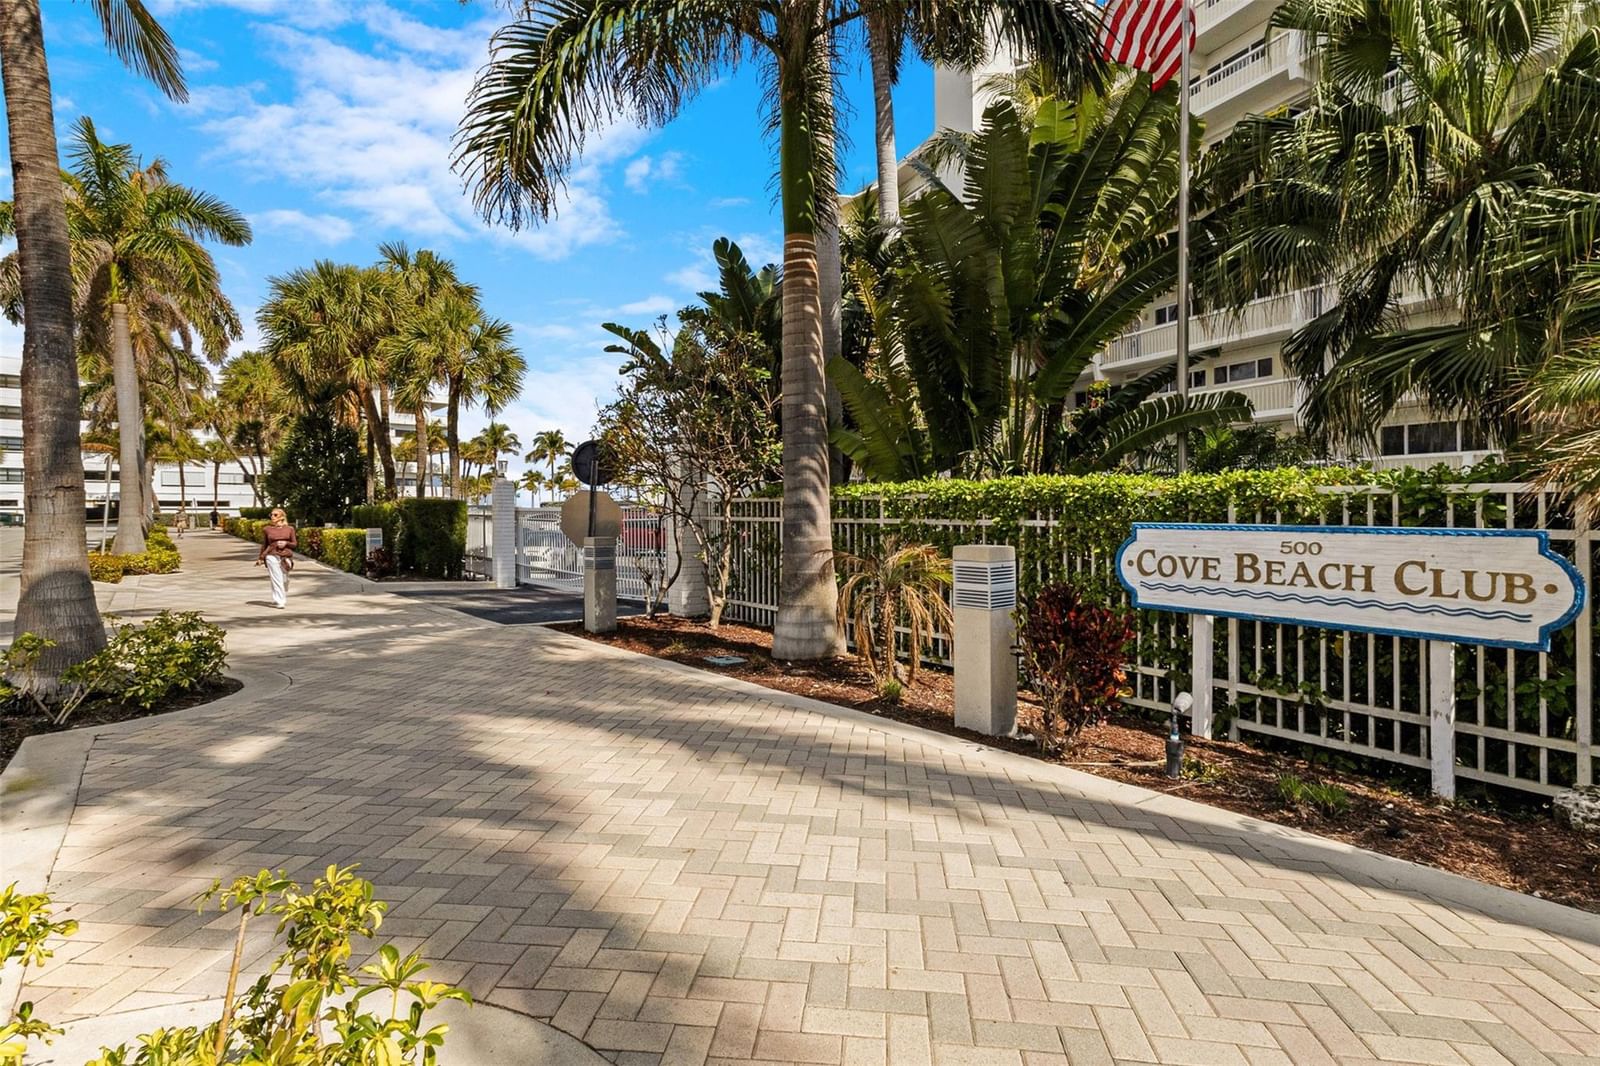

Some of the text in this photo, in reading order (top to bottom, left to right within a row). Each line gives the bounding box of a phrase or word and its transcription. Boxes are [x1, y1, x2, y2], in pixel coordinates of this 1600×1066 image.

[1279, 541, 1323, 556] 500
[1136, 549, 1537, 604] COVE BEACH CLUB
